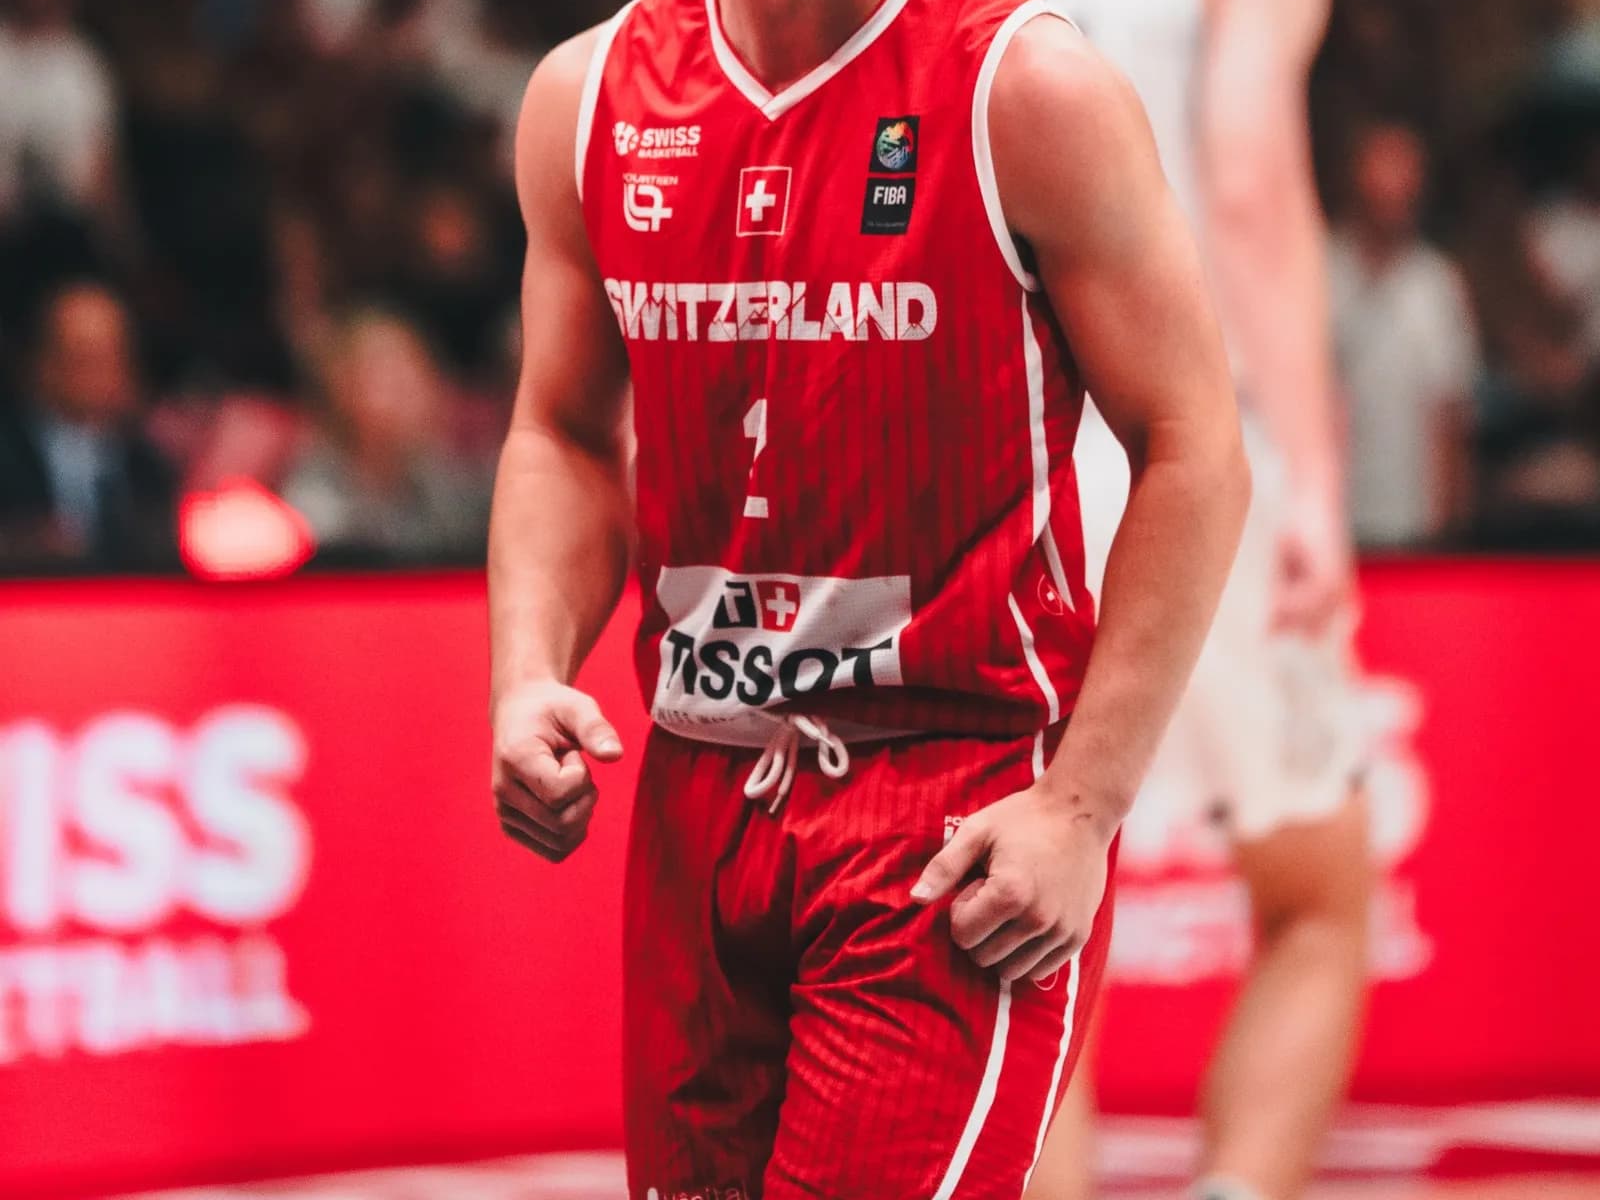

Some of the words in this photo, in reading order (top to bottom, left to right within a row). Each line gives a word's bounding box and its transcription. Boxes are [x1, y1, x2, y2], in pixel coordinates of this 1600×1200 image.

[637, 147, 698, 159] BASKETBALL
[640, 126, 701, 148] SWISS
[872, 185, 907, 205] FIBA
[603, 278, 938, 341] SWITZERLAND
[743, 398, 769, 519] 1
[667, 629, 893, 706] TISSOT
[0, 705, 312, 932] ISS
